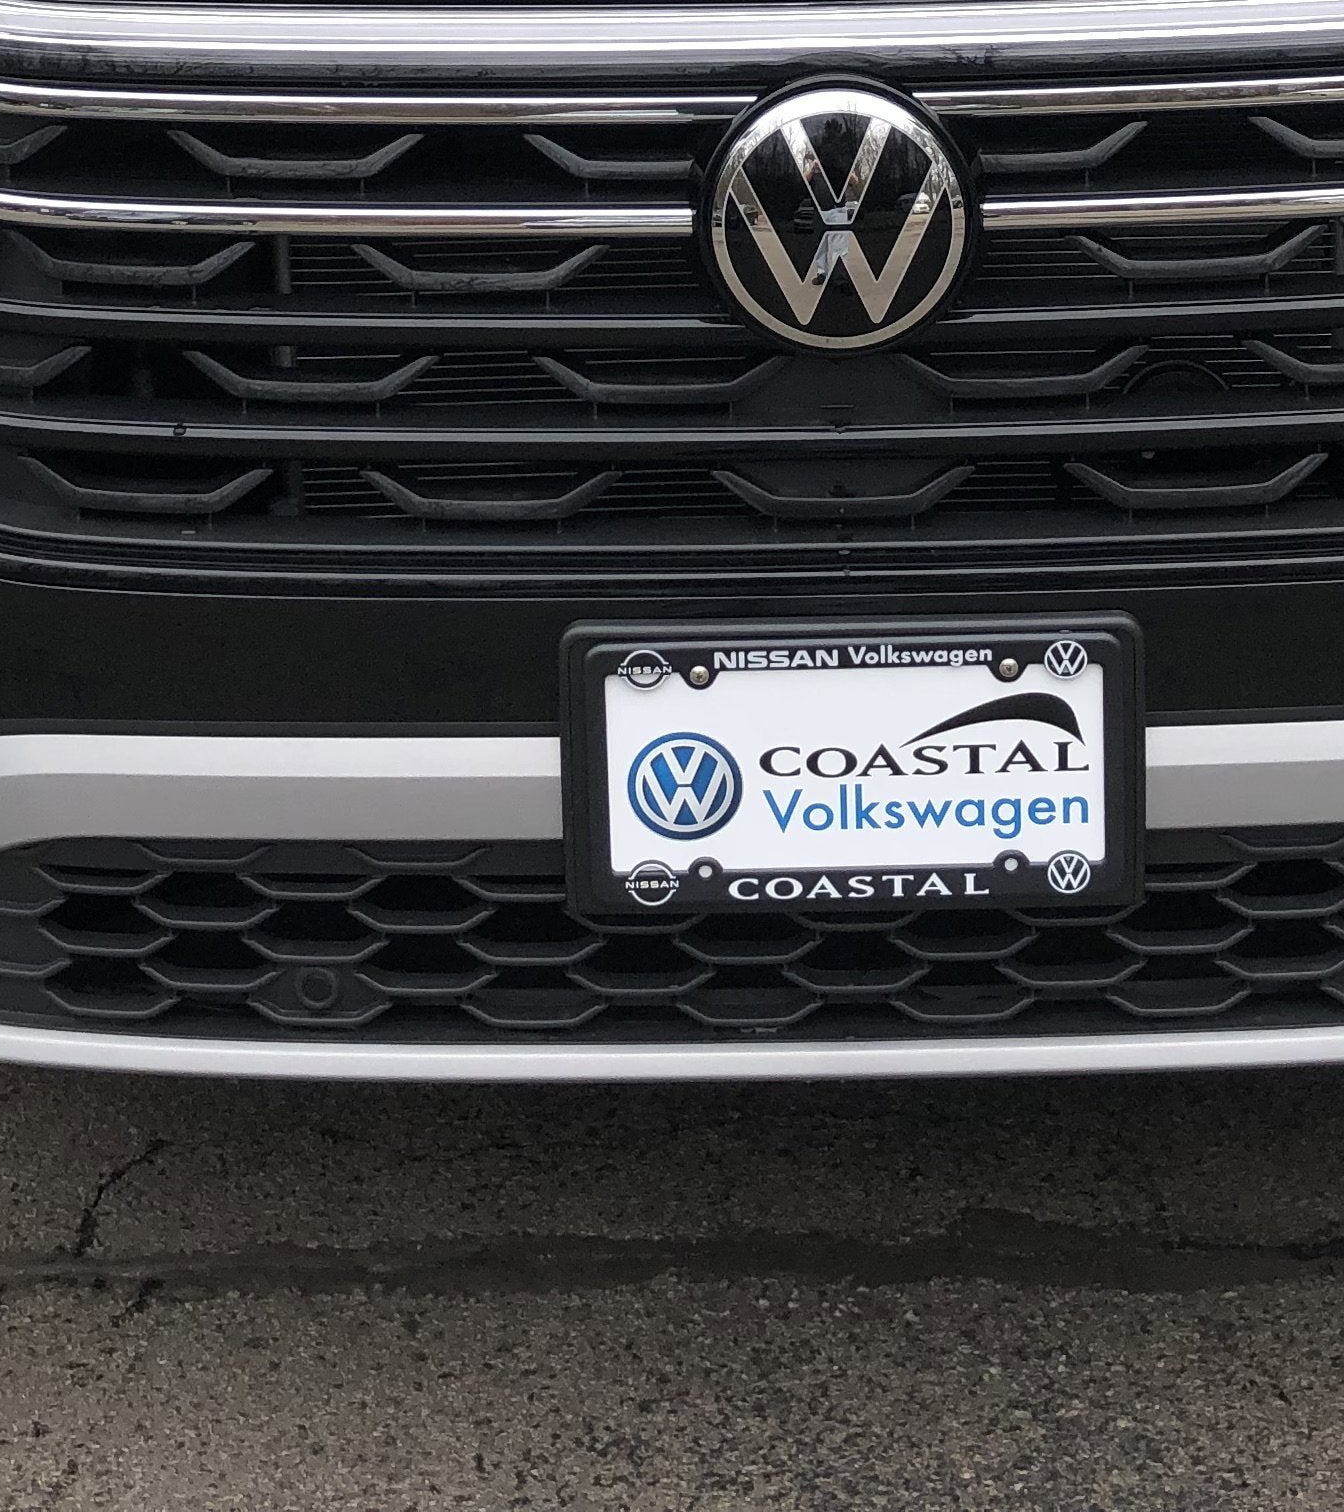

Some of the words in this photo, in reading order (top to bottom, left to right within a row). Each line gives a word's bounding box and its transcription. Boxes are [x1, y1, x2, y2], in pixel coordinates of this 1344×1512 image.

[617, 664, 673, 676] NISSAN
[714, 650, 839, 669] NISSAN
[848, 645, 993, 666] Volkswagen
[759, 739, 1090, 778] COASTAL
[762, 784, 1090, 839] Volkswagen
[625, 879, 680, 890] NISSAN
[728, 872, 990, 900] COASTAL
